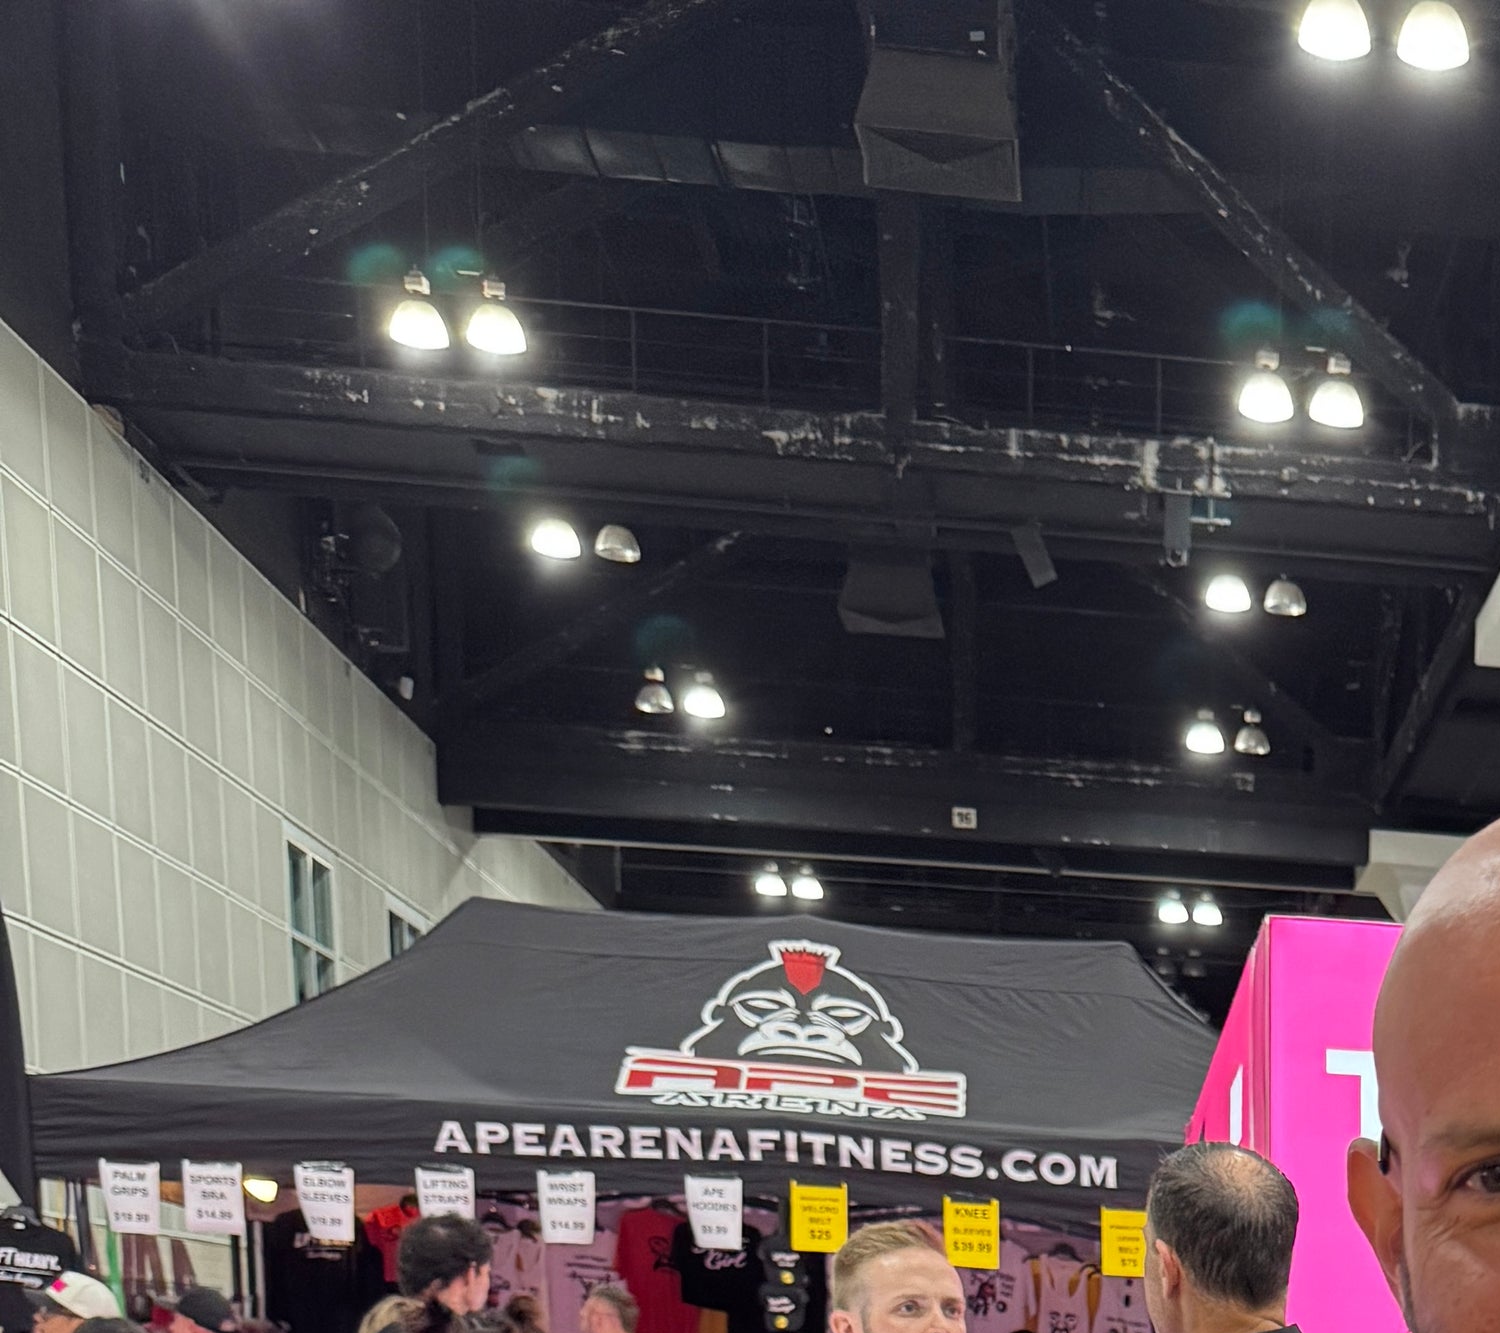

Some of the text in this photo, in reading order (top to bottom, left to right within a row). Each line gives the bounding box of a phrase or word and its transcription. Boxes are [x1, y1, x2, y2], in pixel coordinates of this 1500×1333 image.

[650, 1090, 928, 1122] ARENA
[433, 1120, 1119, 1190] APEARENAFITNESS.COM
[954, 1208, 990, 1220] KNEE
